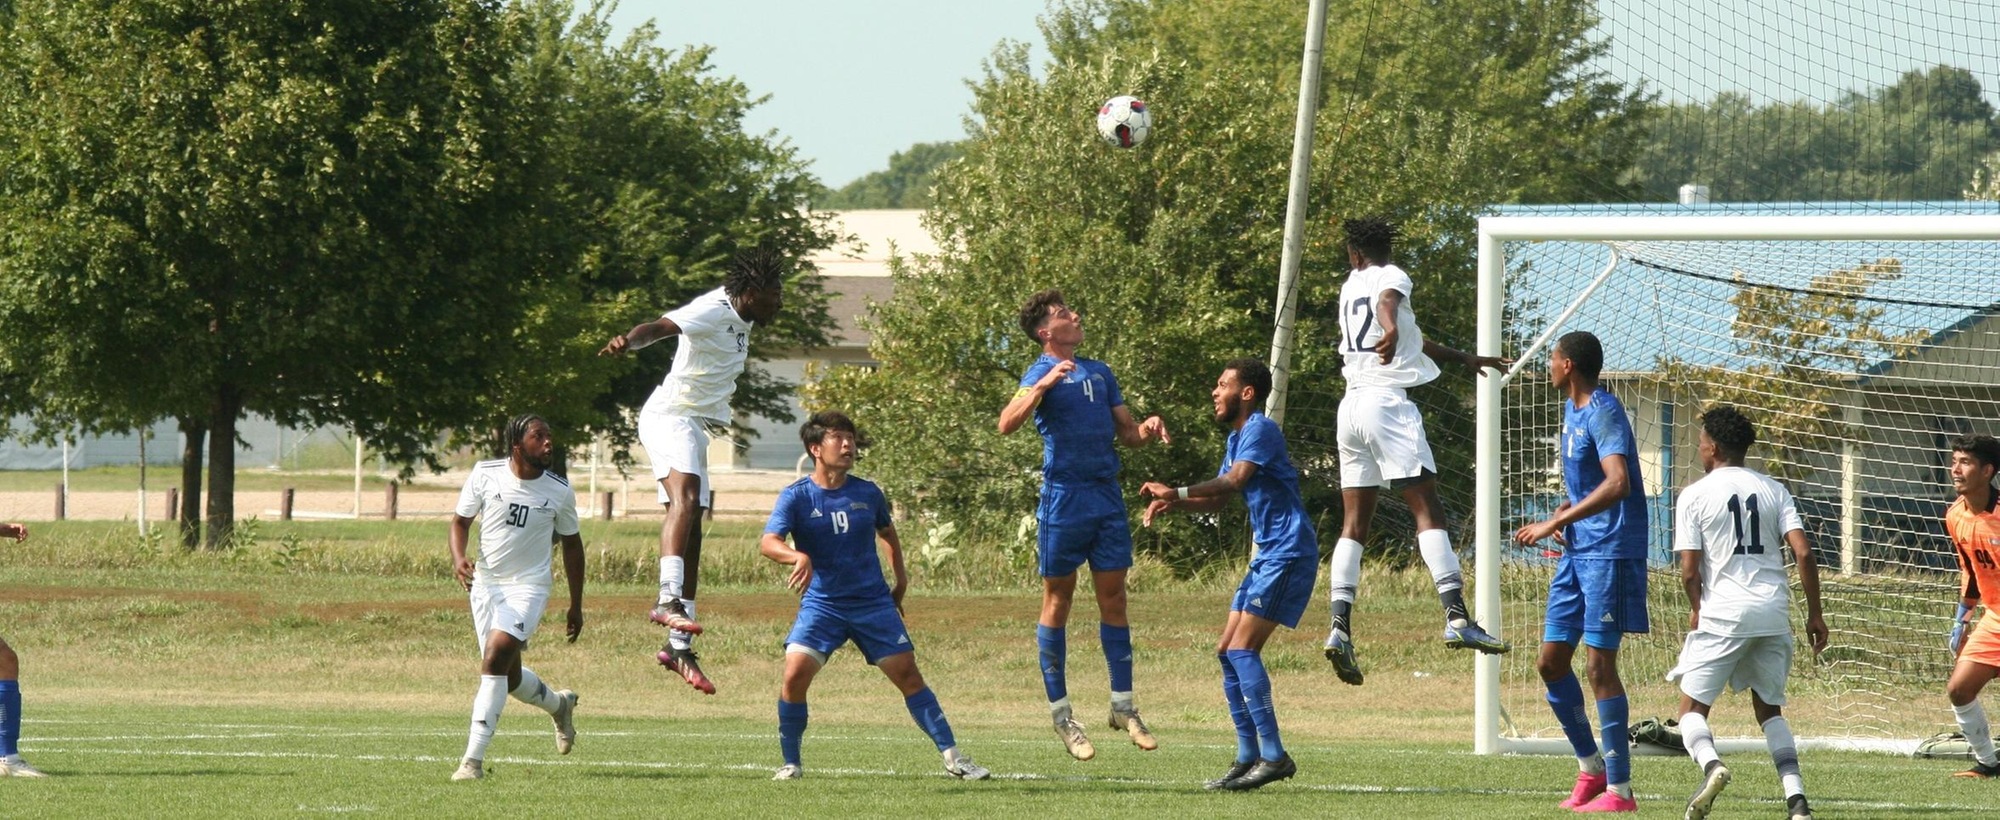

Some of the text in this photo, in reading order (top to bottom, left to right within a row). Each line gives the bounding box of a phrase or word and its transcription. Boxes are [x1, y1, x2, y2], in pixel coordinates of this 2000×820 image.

[1343, 296, 1377, 352] 12
[1082, 378, 1094, 402] 4
[506, 503, 529, 528] 30
[830, 510, 849, 535] 19
[1727, 493, 1764, 555] 11
